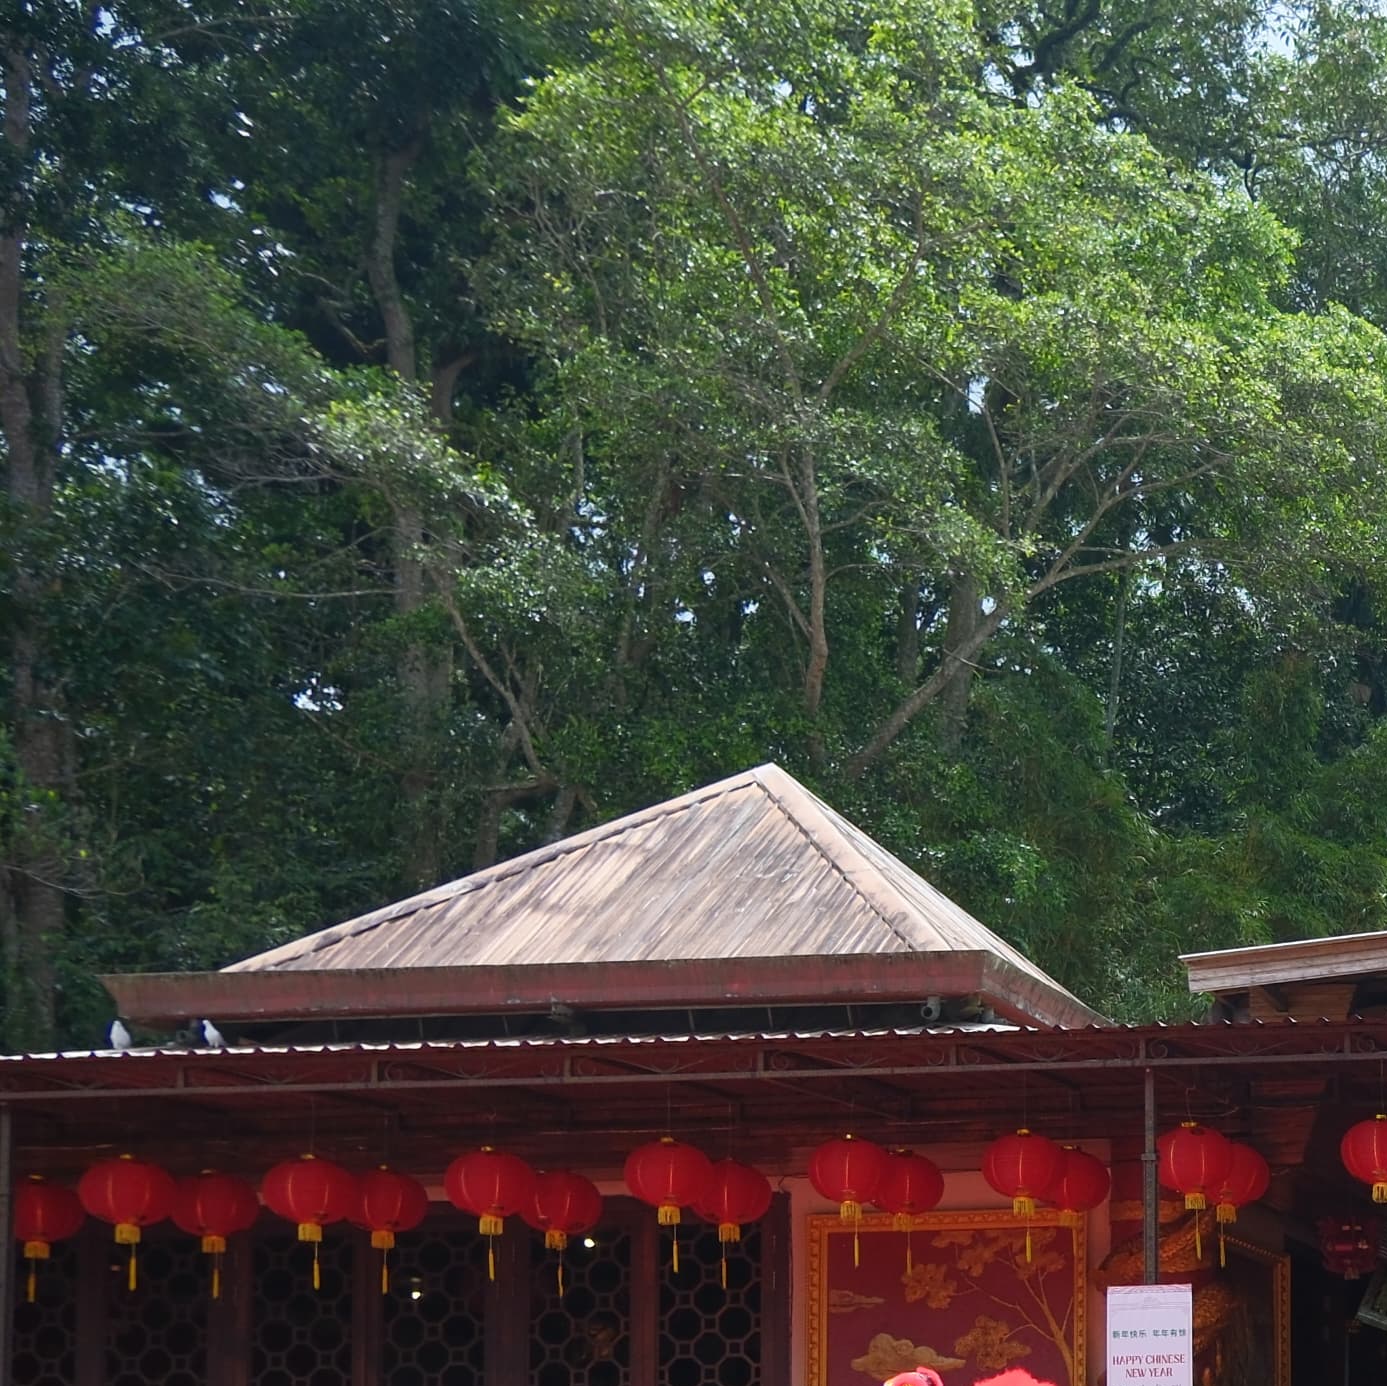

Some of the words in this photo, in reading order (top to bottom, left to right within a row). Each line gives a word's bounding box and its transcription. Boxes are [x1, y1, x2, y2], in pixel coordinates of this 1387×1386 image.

[1112, 1355, 1143, 1365] HAPPY
[1145, 1354, 1185, 1364] CHINESE
[1126, 1368, 1147, 1378] NEW
[1149, 1367, 1173, 1377] YEAR
